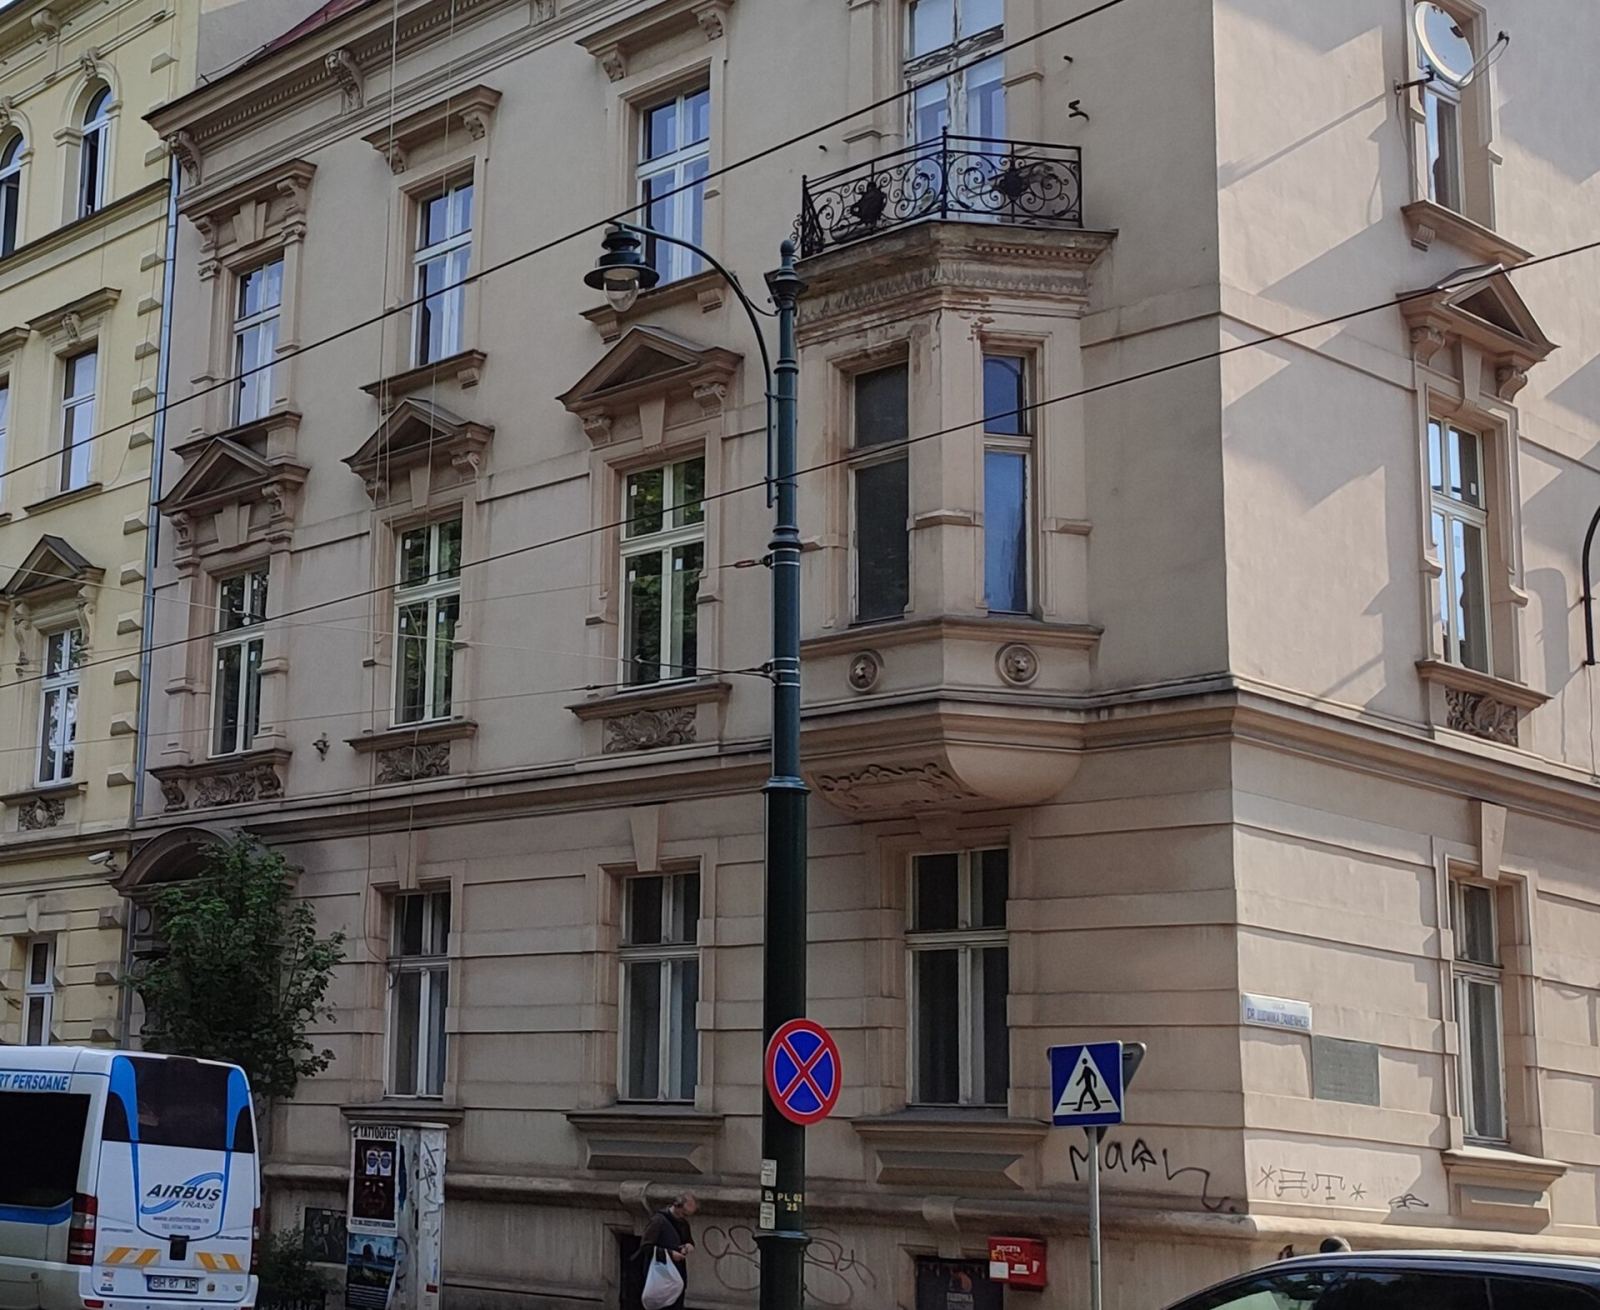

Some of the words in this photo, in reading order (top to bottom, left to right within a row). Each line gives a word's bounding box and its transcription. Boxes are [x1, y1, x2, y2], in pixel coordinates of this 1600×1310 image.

[12, 1074, 69, 1091] PERSOANE
[360, 1126, 399, 1139] TATTOOFEST
[146, 1183, 222, 1202] AIRBUS
[181, 1200, 215, 1210] TRANS
